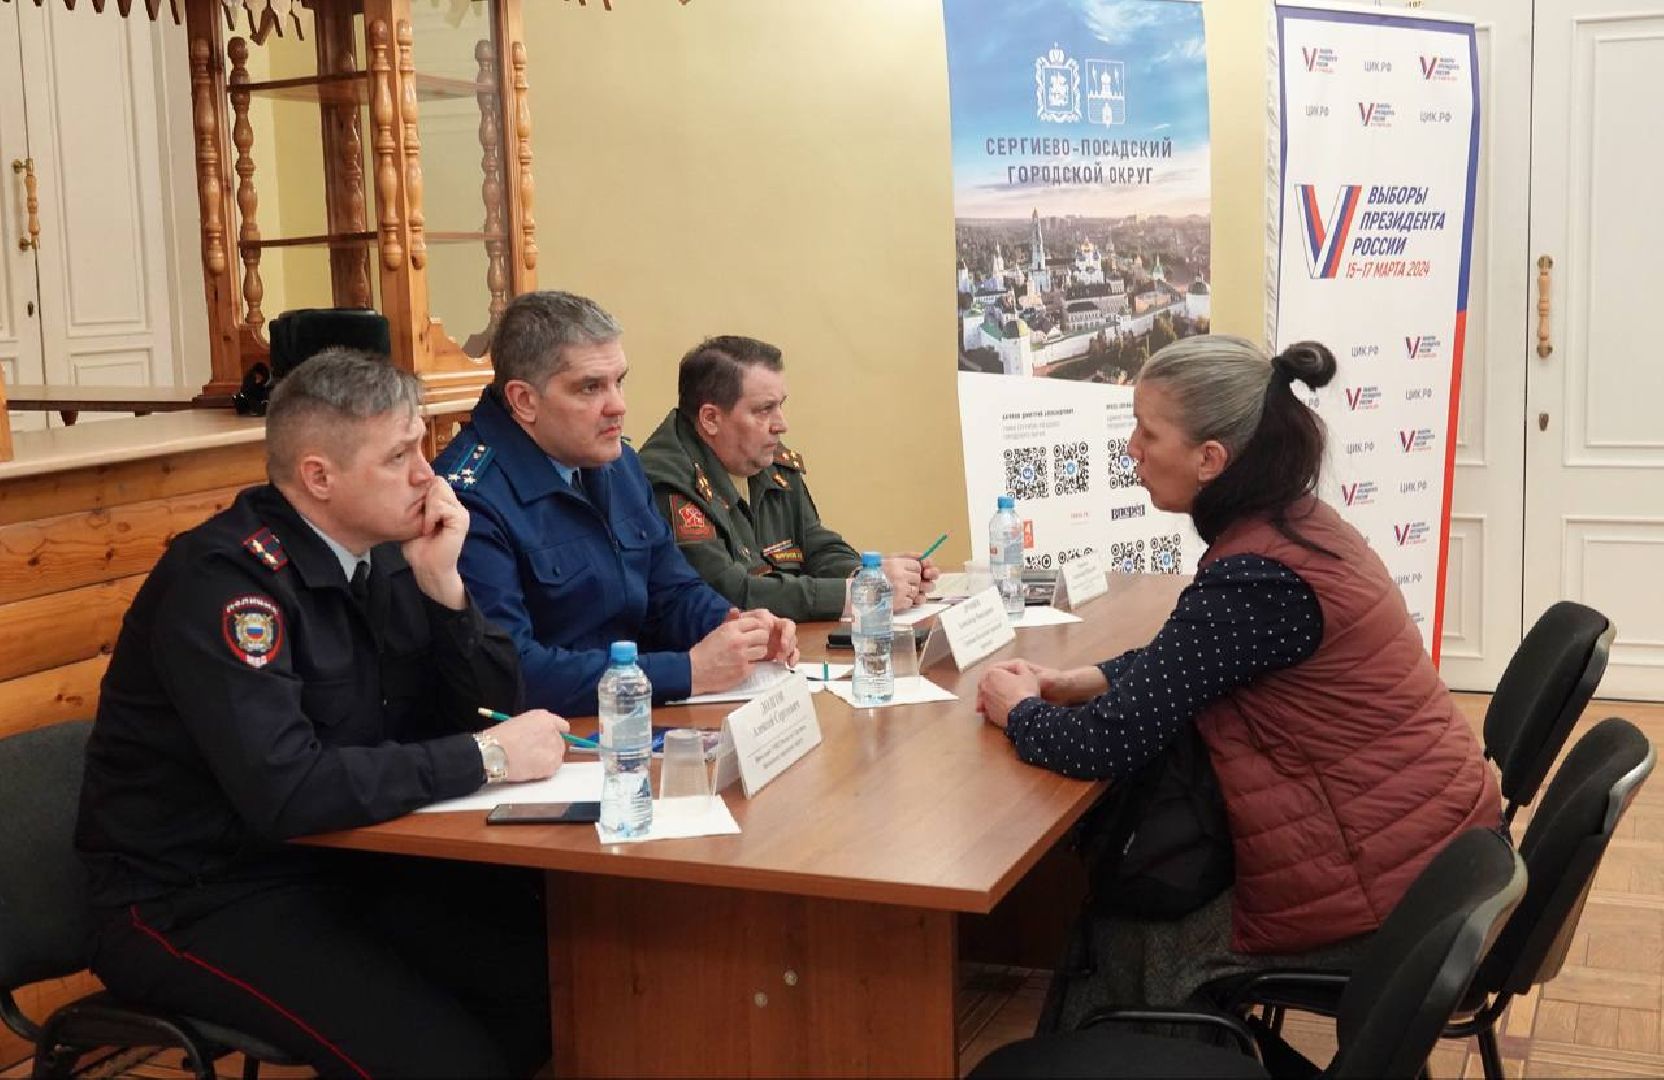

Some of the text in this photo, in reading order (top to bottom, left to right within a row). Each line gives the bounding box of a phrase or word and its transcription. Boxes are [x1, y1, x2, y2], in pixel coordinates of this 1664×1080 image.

[985, 136, 1173, 159] СЕРГИЕВО-ПОСАДСКИЙ
[1007, 162, 1154, 185] ГОРОДСКОЙ ОКРУГ
[1367, 186, 1429, 205] ВЫБОРЫ
[1360, 210, 1446, 233] ПРЕЗИДЕНТА
[1352, 236, 1408, 257] РОССИИ
[1374, 261, 1405, 278] МАРТА
[1406, 260, 1431, 277] 2024
